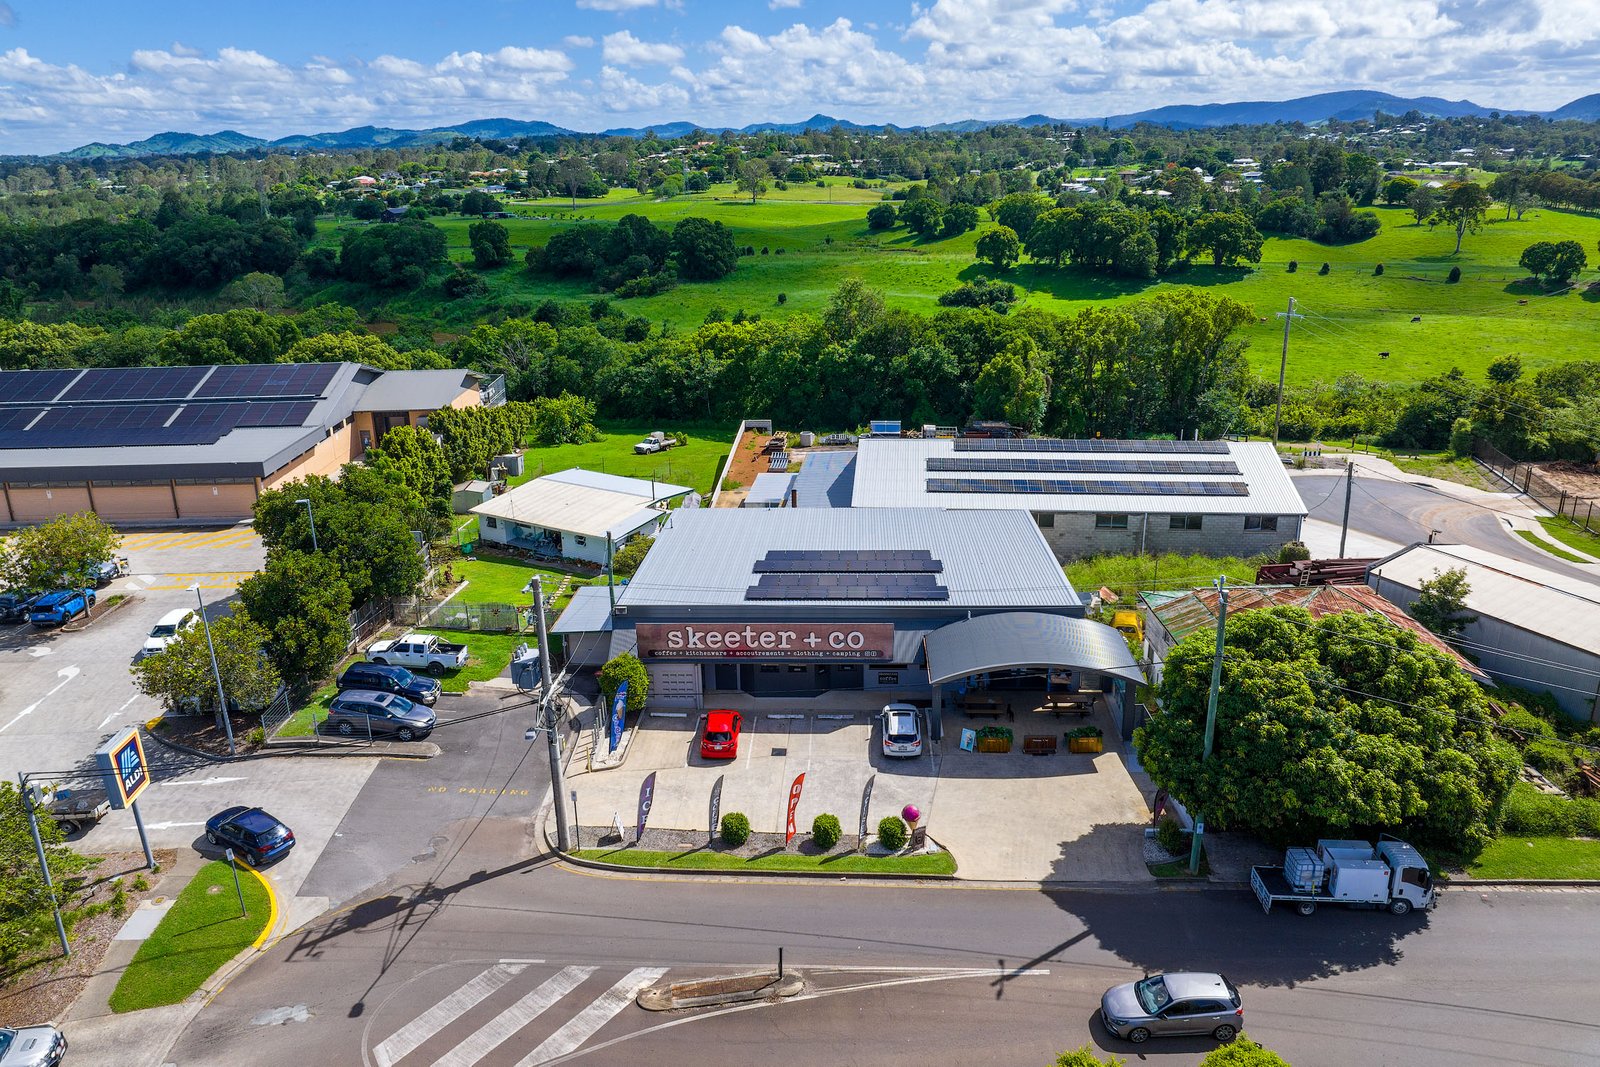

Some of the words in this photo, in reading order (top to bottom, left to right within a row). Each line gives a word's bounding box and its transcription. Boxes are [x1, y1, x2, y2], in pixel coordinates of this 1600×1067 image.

[667, 625, 797, 649] skeeter
[828, 631, 865, 649] co
[125, 767, 143, 791] ALDI
[459, 787, 529, 795] PARKING
[788, 784, 801, 834] OPEN
